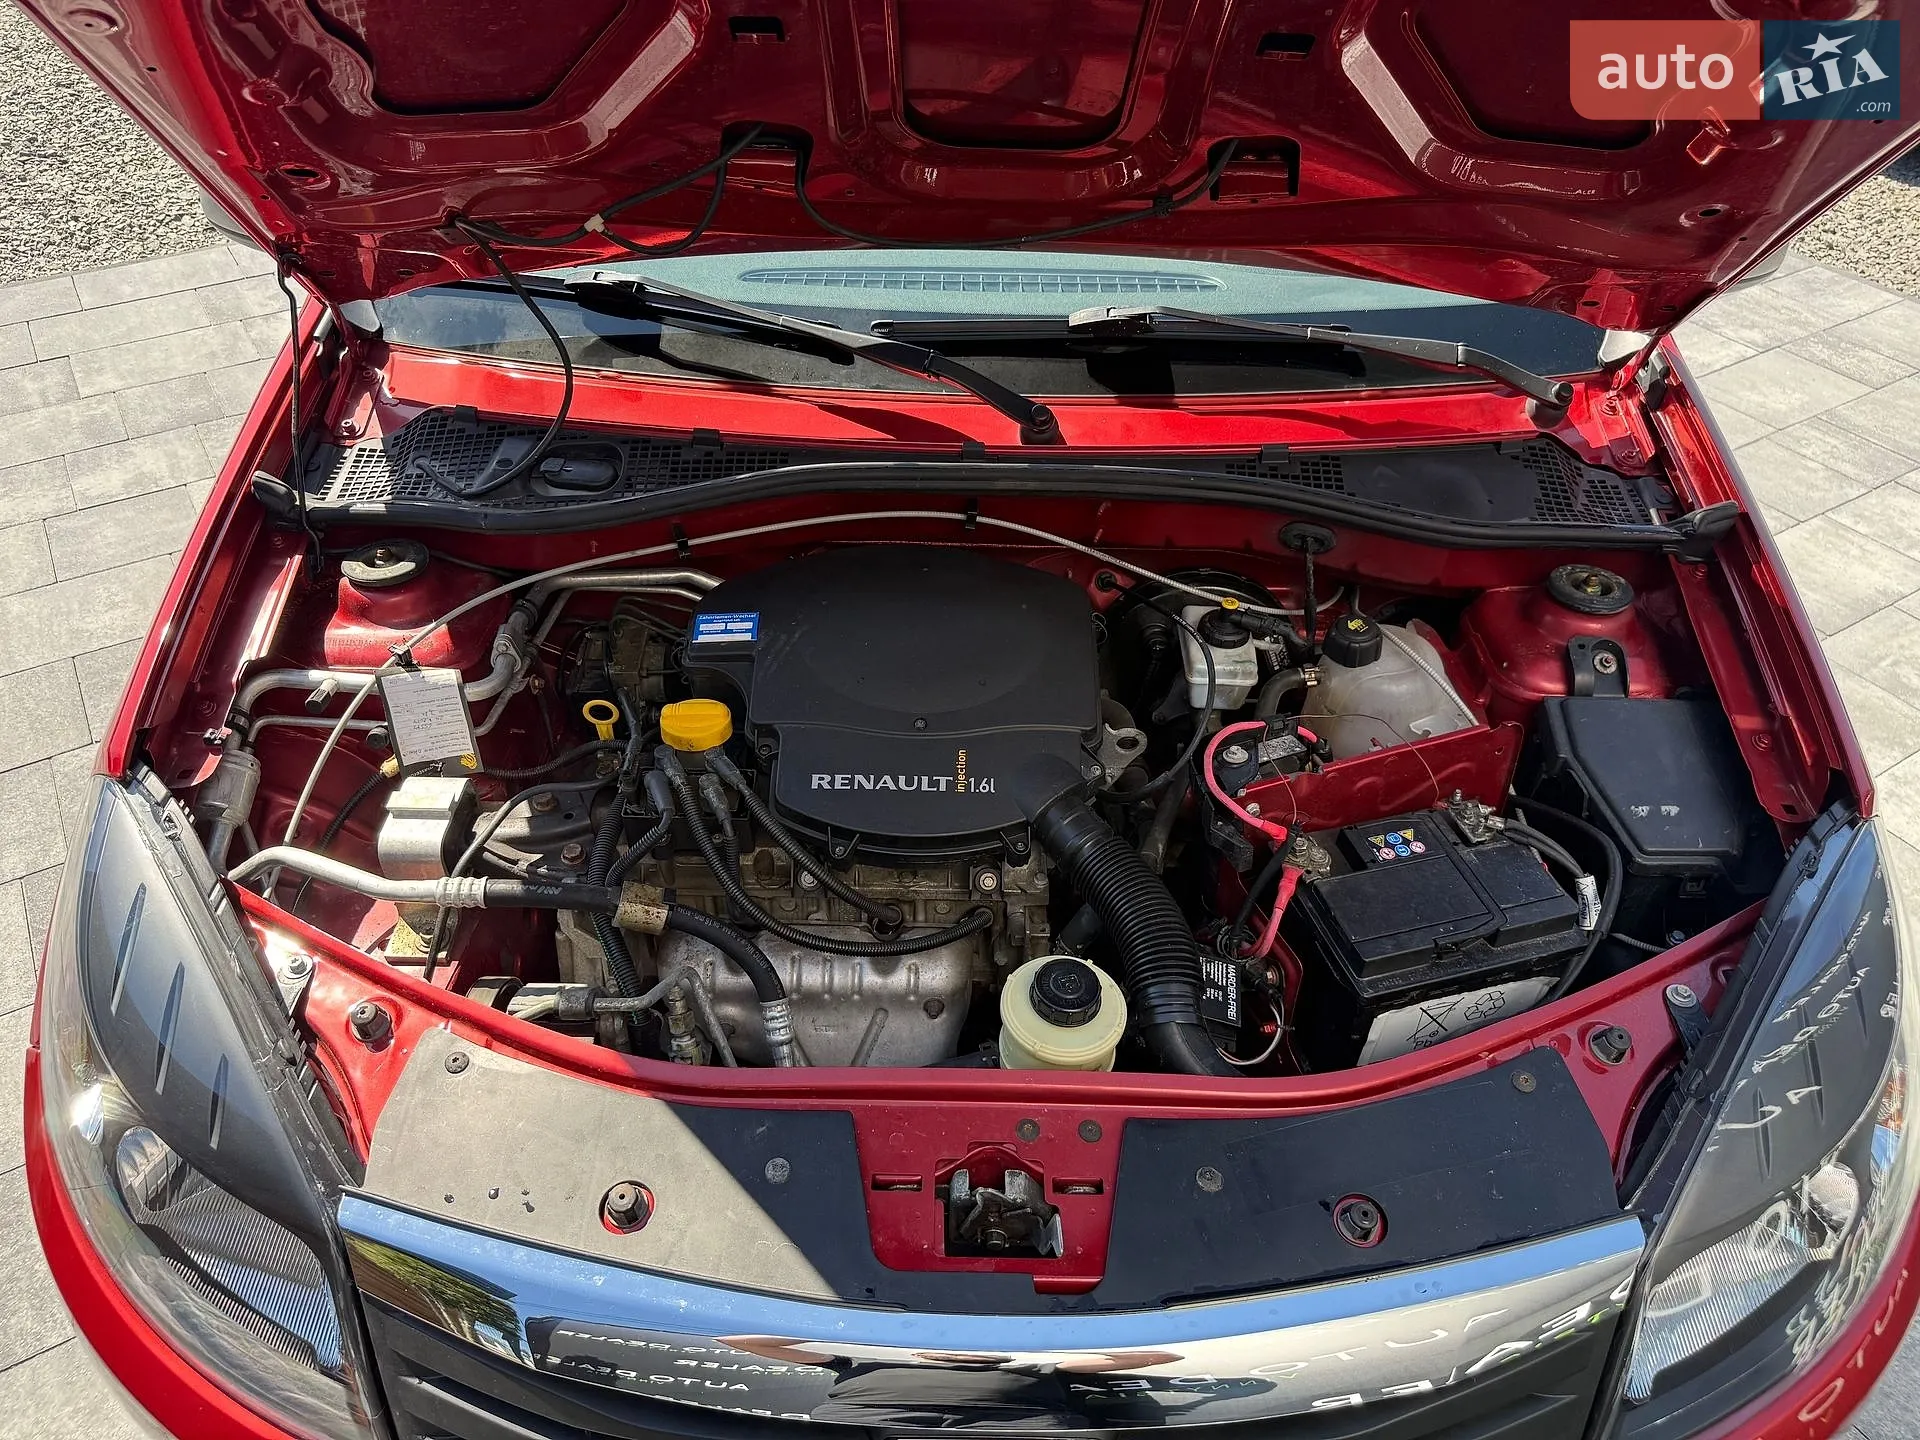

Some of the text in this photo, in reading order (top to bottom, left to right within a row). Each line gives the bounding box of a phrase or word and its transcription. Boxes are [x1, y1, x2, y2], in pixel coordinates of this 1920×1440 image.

[811, 773, 954, 792] RENAULT
[954, 749, 967, 793] injection
[1227, 963, 1238, 1022] MARDER-FREI
[1413, 1040, 1433, 1050] Pb
